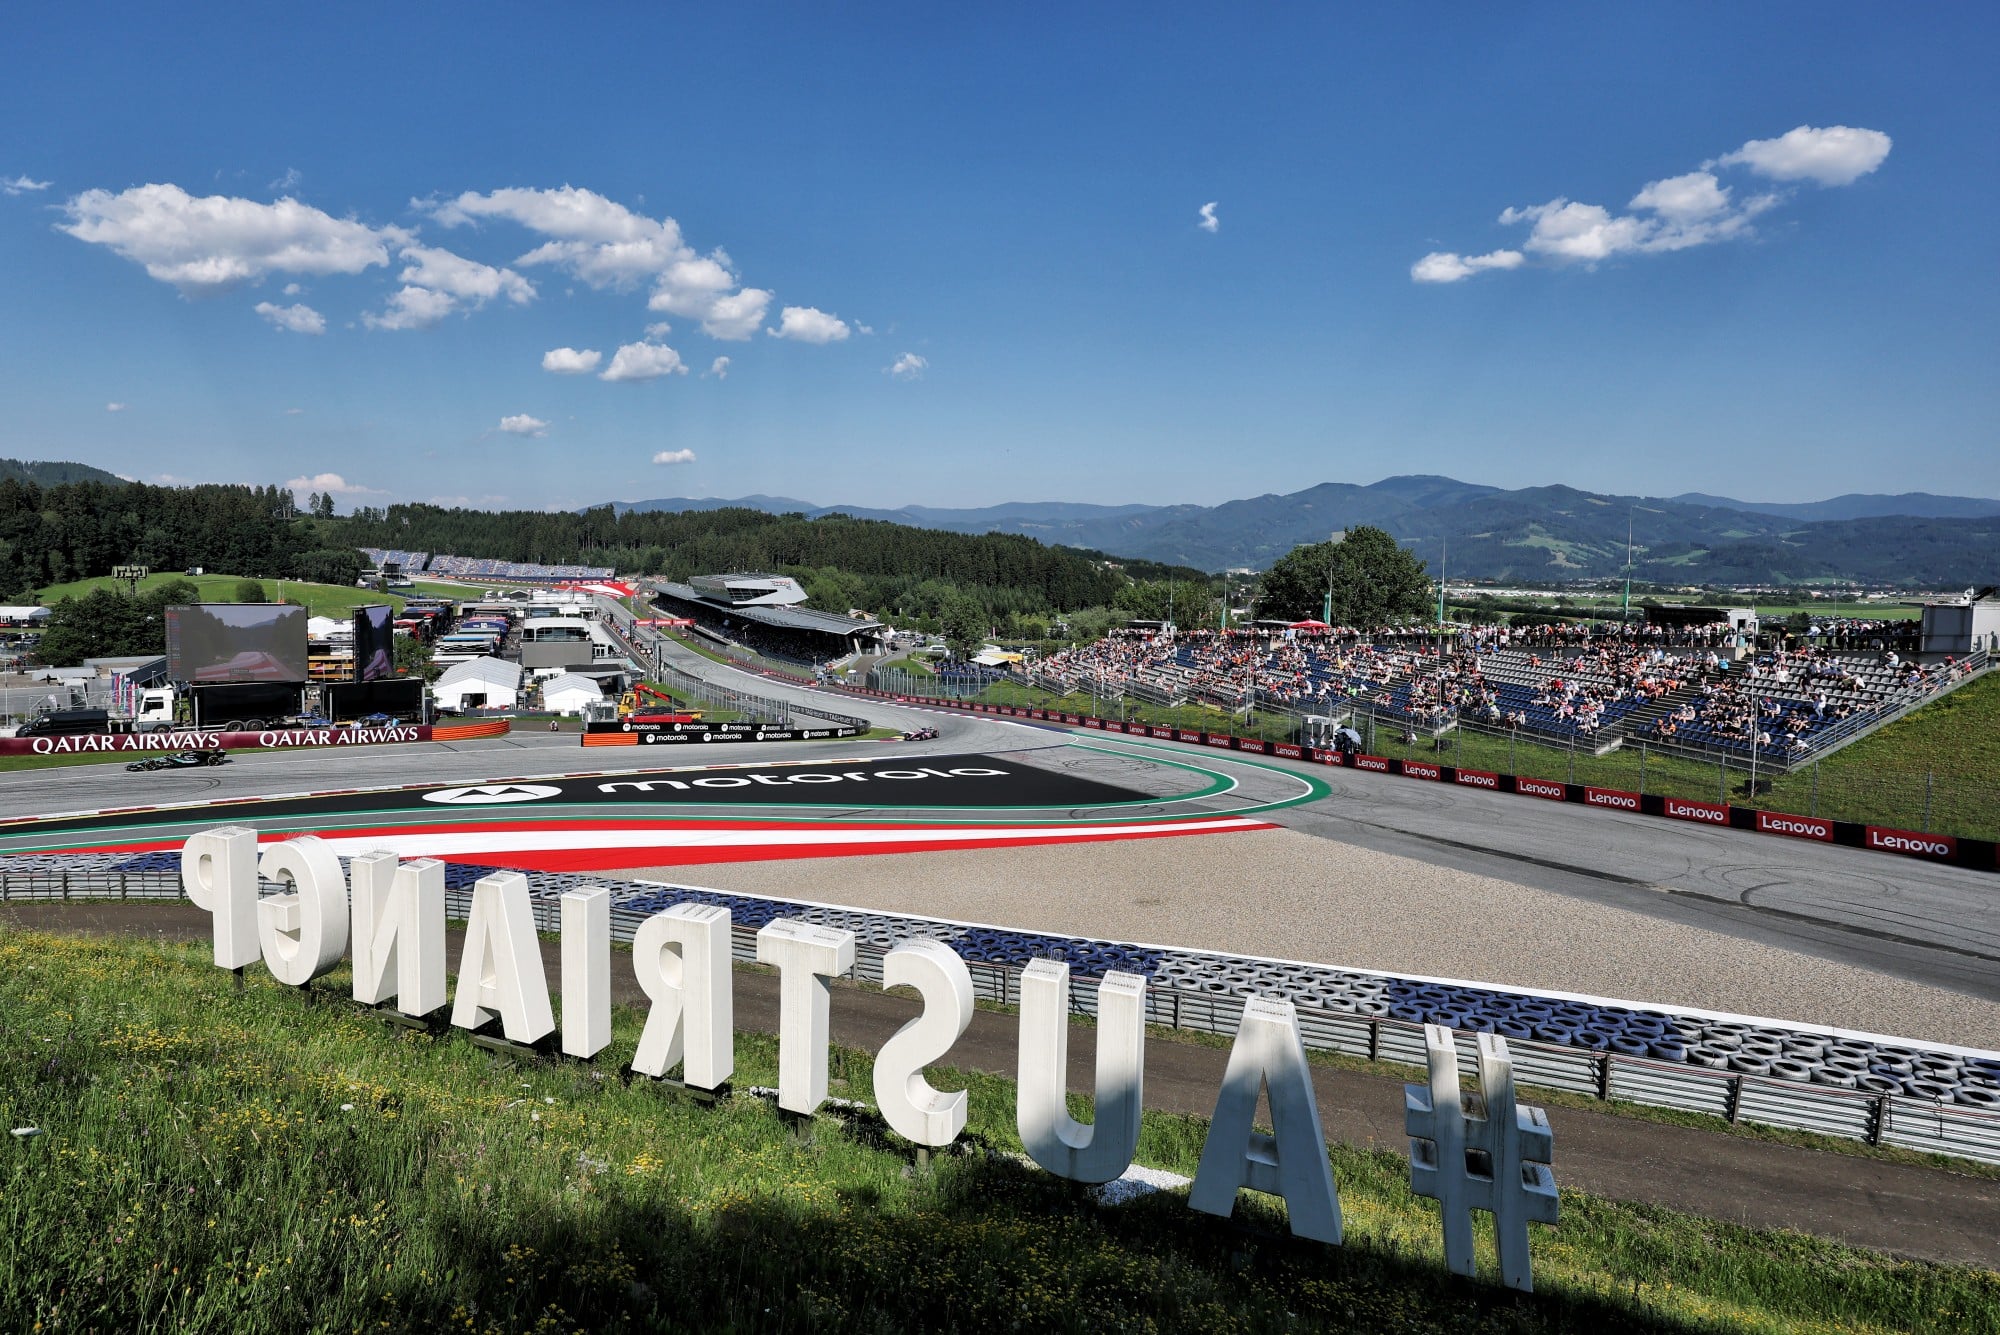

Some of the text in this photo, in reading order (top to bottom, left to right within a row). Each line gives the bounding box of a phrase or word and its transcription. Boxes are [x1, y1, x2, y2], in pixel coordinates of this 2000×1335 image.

[712, 732, 742, 740] motorola
[1129, 725, 1145, 734] Lenovo
[1153, 729, 1171, 738] Lenovo
[32, 733, 220, 754] QATAR AIRWAYS
[259, 727, 418, 747] QATAR AIRWAYS
[1180, 732, 1199, 742] Lenovo
[1209, 736, 1229, 746] Lenovo
[1241, 740, 1263, 751] Lenovo
[1275, 745, 1300, 757] Lenovo
[1314, 751, 1341, 763] Lenovo
[1357, 757, 1386, 770] Lenovo
[1405, 764, 1437, 777] Lenovo
[597, 768, 1010, 793] motorola
[1458, 772, 1495, 787] Lenovo
[1519, 780, 1561, 797] Lenovo
[1588, 790, 1636, 809] Lenovo
[1669, 801, 1724, 821] Lenovo
[1762, 815, 1826, 838] Lenovo
[1873, 831, 1949, 856] Lenovo
